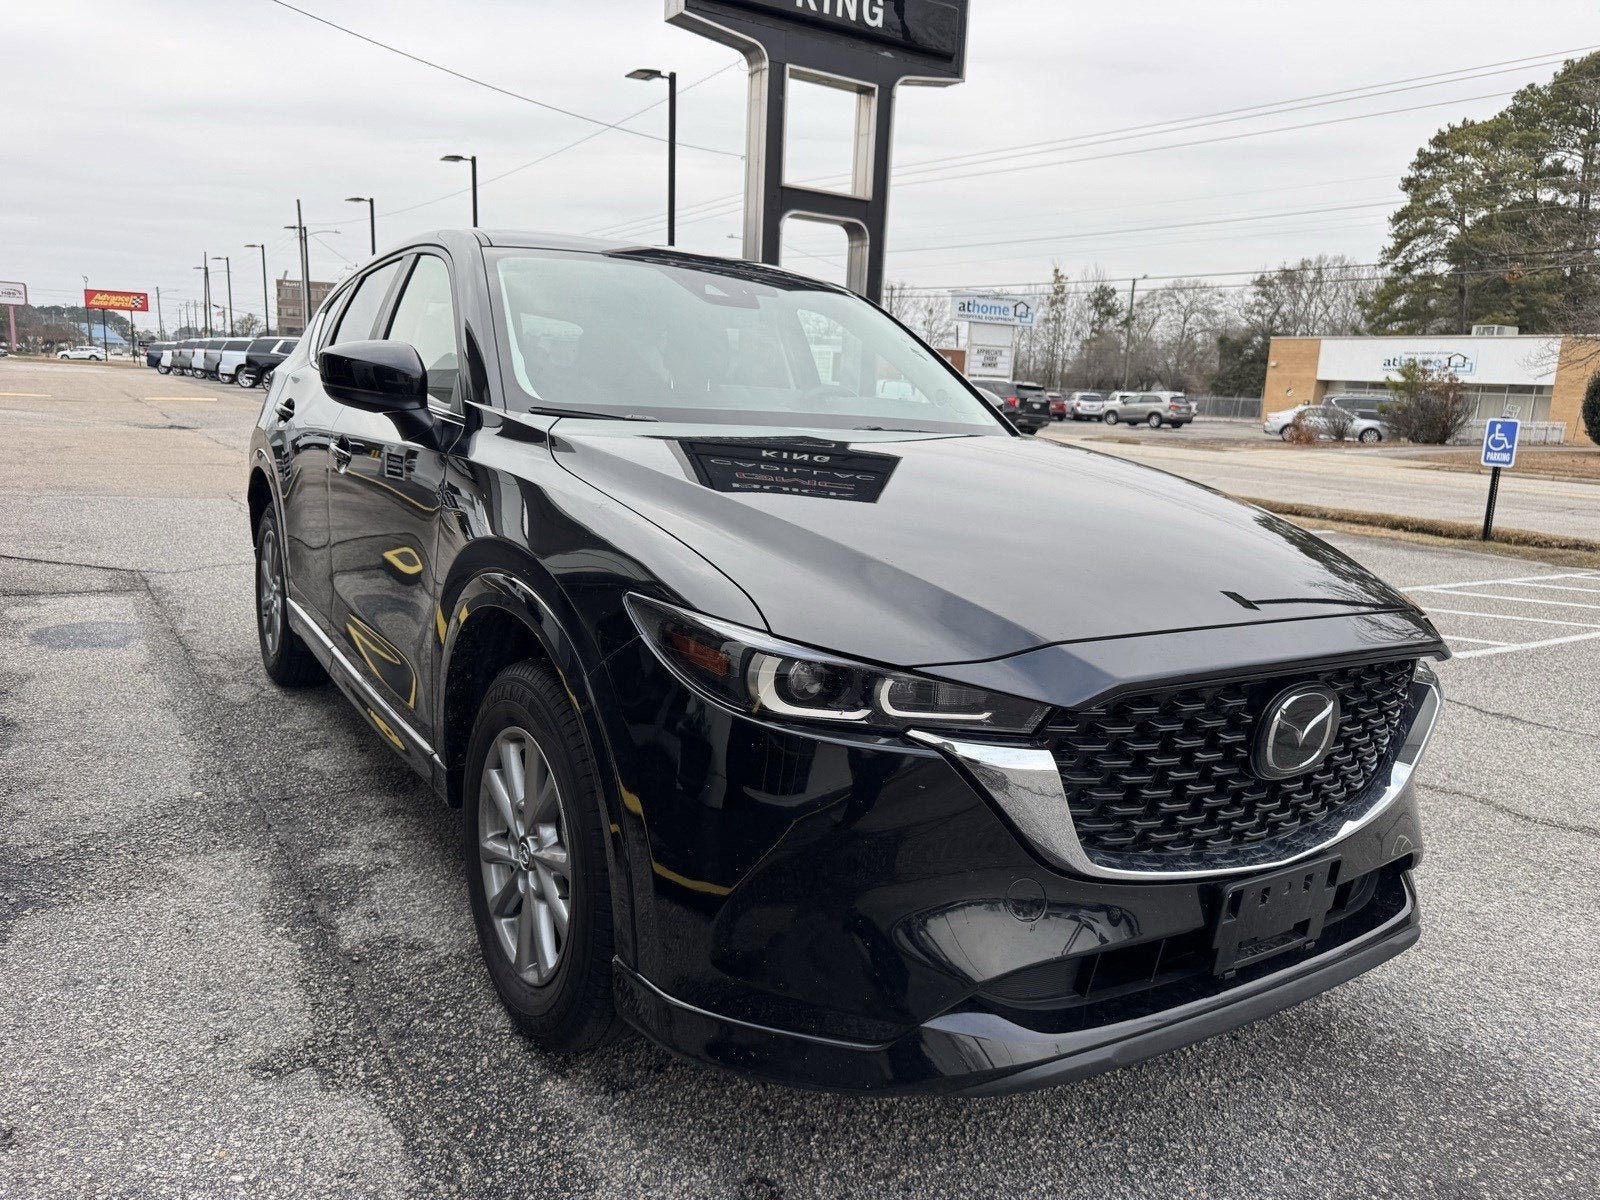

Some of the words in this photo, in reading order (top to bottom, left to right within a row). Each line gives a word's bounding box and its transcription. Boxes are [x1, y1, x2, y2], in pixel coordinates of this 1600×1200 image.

[796, 0, 884, 28] NG
[93, 293, 130, 301] Advance
[958, 299, 1010, 316] athome
[1383, 356, 1441, 367] athe
[1486, 451, 1511, 462] PARKING
